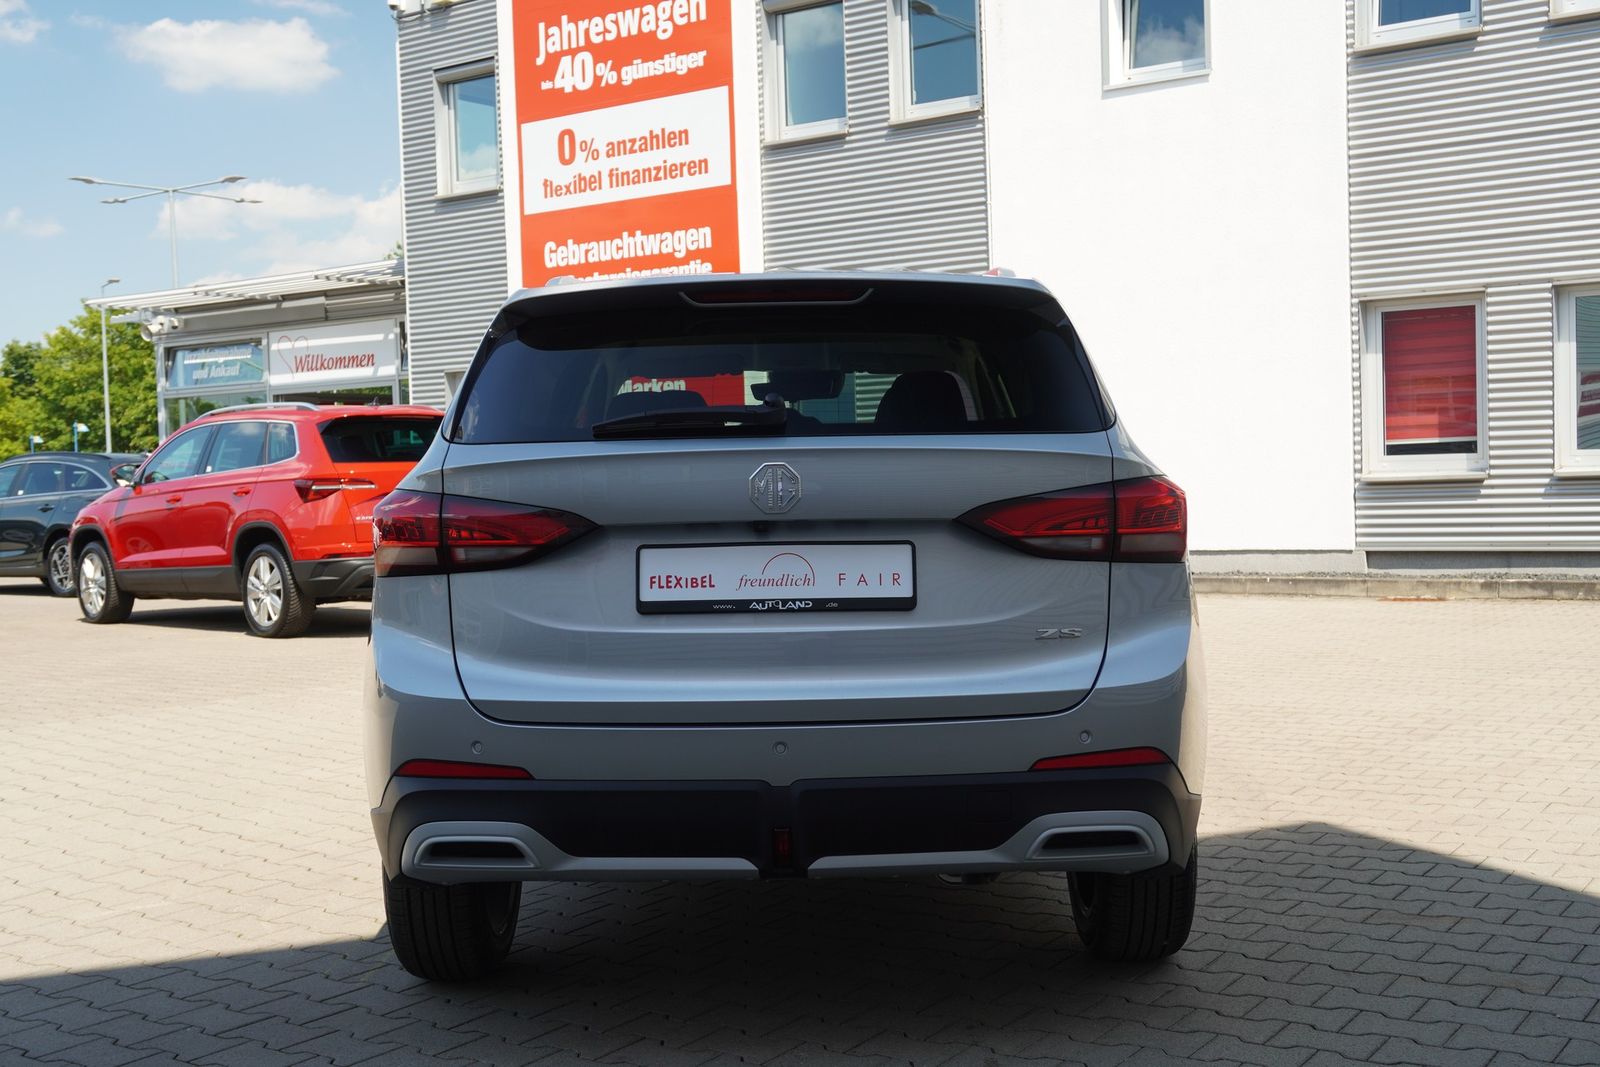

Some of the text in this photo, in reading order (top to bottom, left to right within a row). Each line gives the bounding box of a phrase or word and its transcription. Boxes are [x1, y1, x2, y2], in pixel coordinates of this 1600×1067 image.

[536, 0, 707, 65] Jahreswagen
[553, 51, 594, 93] 40
[595, 60, 618, 87] %
[621, 50, 707, 85] günstiger
[558, 127, 690, 166] 0 % anzahlen
[542, 158, 709, 199] flexibel finanzieren
[544, 225, 712, 268] Gebrauchtwagen
[294, 350, 376, 374] Willkommen
[617, 378, 687, 396] Marken
[753, 466, 797, 510] MG
[649, 572, 902, 592] FLEXIBEL freundlich FAIR
[1035, 627, 1083, 641] ZS
